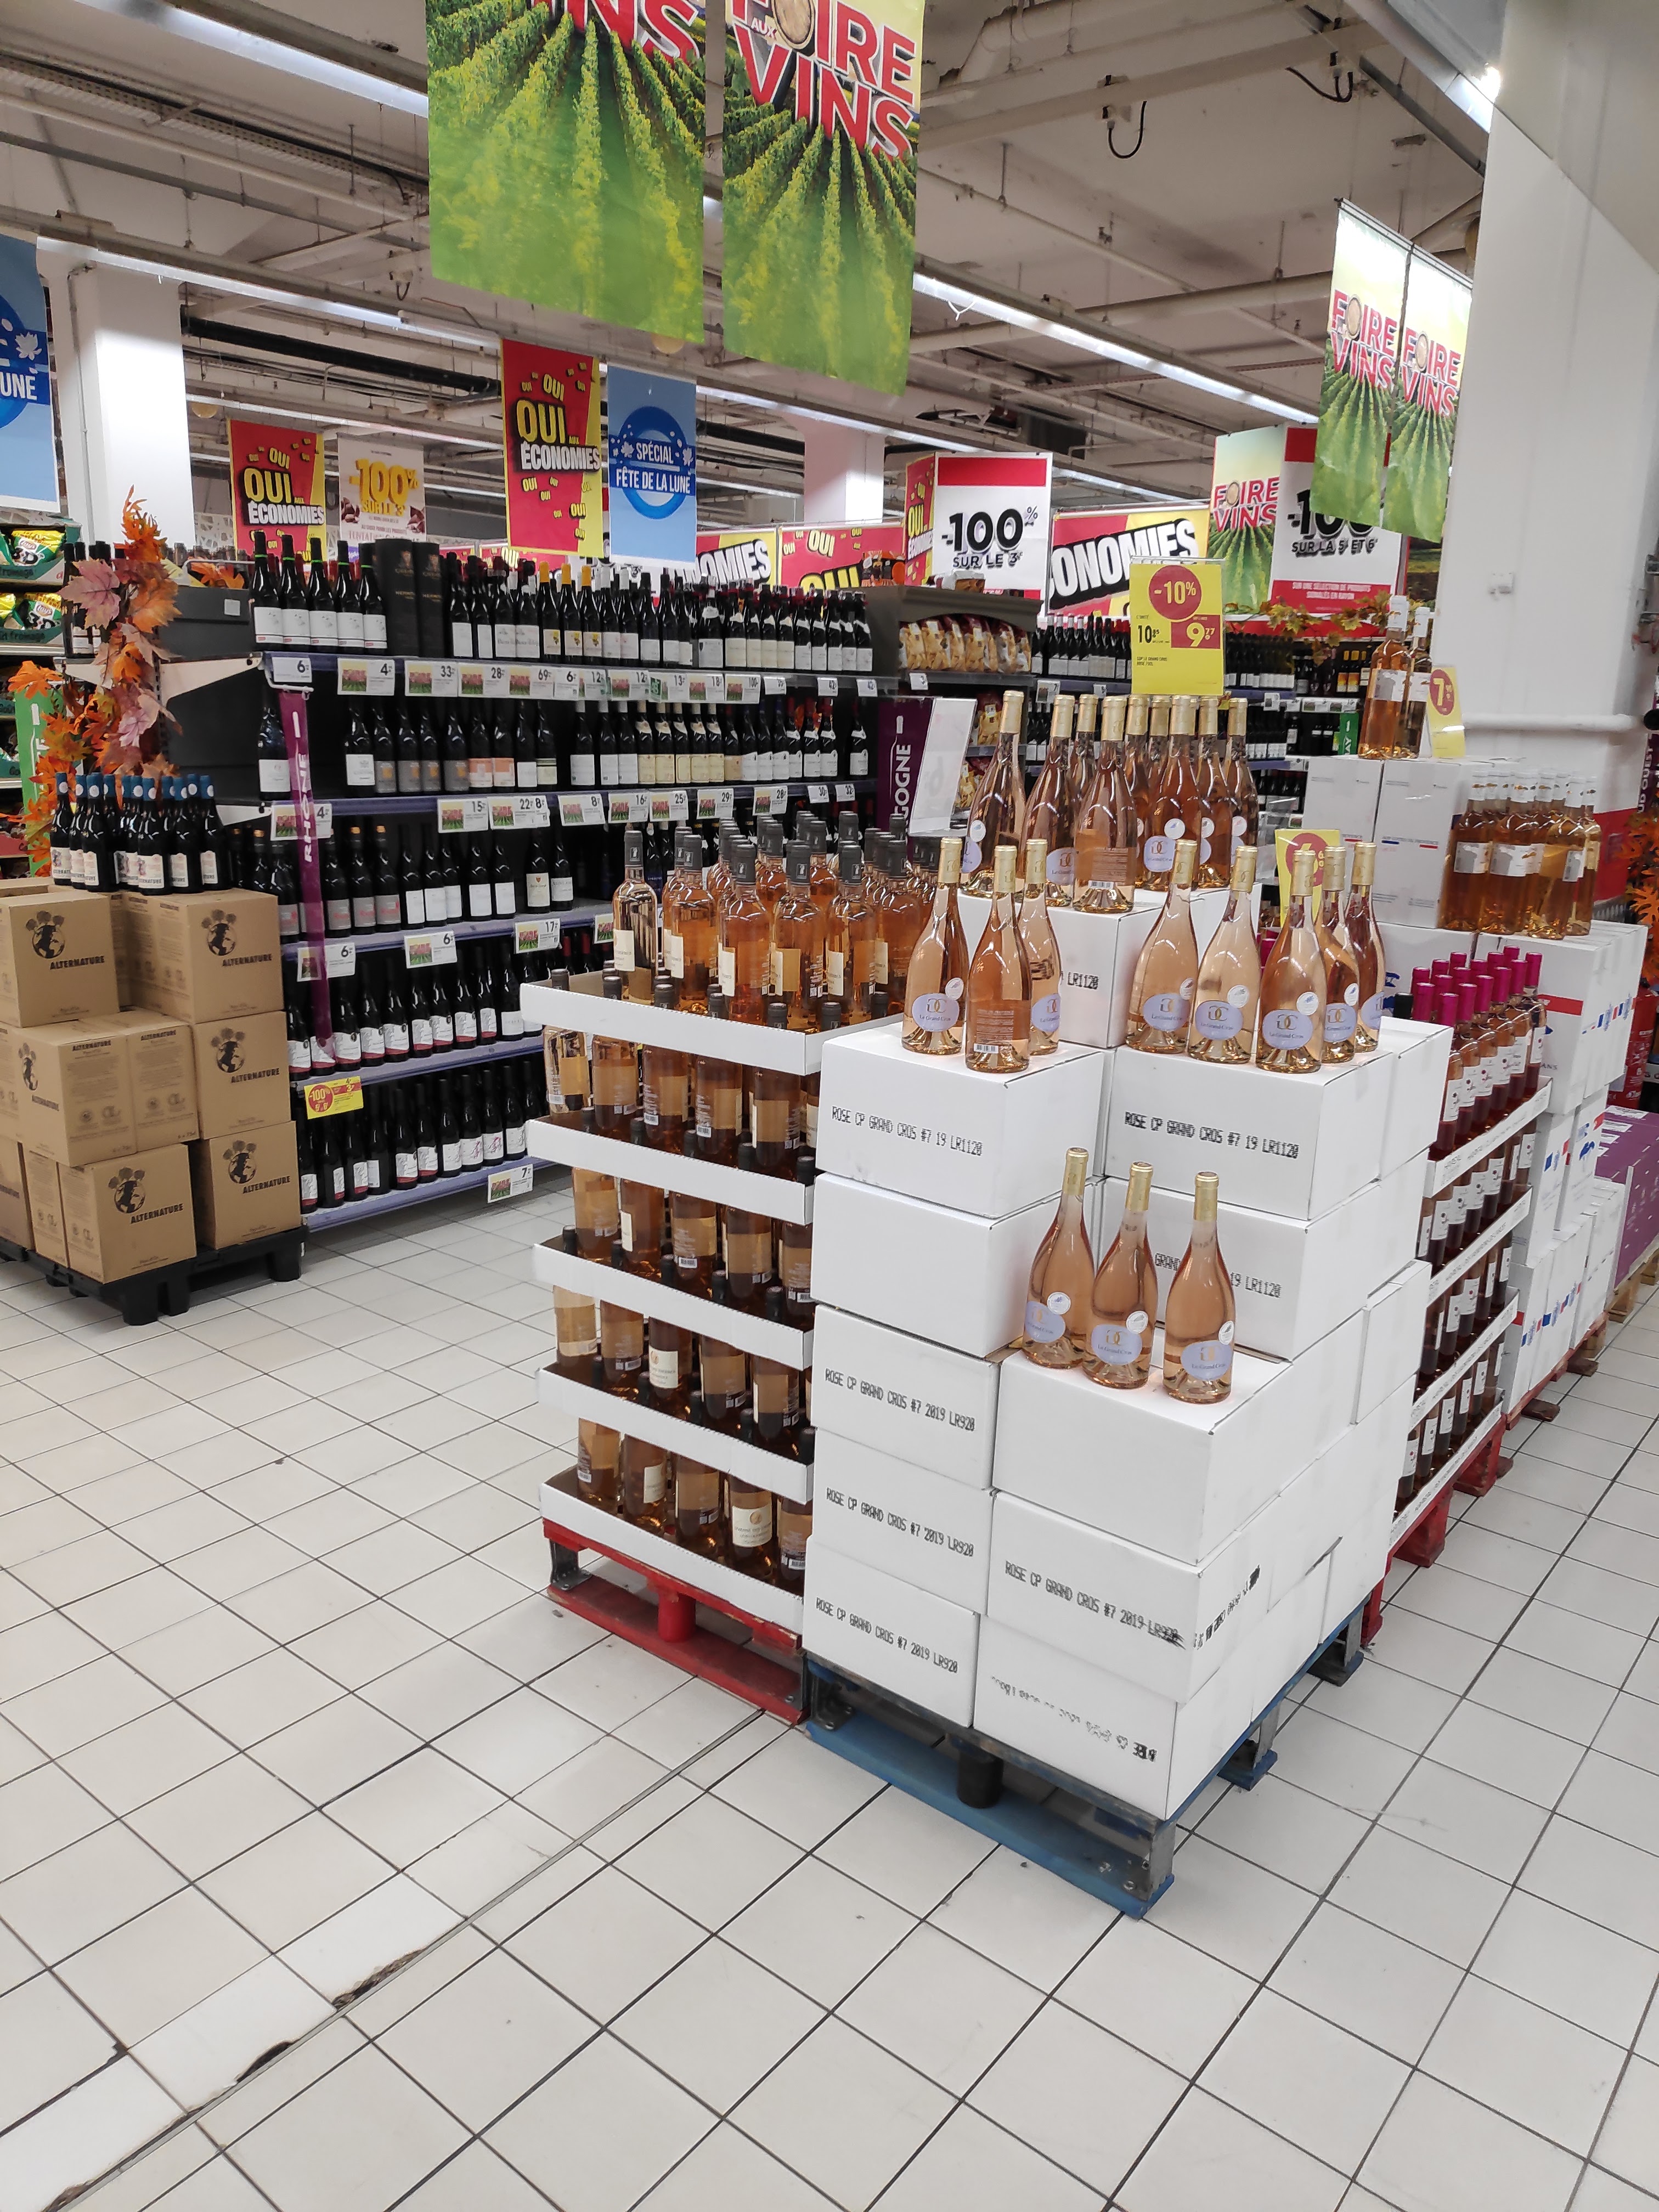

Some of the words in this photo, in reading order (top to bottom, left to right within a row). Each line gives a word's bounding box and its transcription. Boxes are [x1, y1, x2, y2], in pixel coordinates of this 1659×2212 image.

[751, 16, 777, 40] AUX
[733, 23, 915, 163] VINS
[1331, 290, 1397, 357] FOIRE
[1330, 331, 1393, 389] VINS
[1402, 327, 1462, 387] FOIRE
[0, 372, 37, 400] UNE
[543, 374, 565, 402] OUI
[1402, 364, 1457, 416] VINS
[517, 399, 566, 444] OUI
[269, 448, 290, 469] OUI
[521, 441, 601, 470] ÉCONOMIES
[636, 440, 674, 465] SPÉCIAL
[244, 468, 292, 504] OUI
[522, 477, 538, 492] OUI
[616, 466, 640, 489] FÊTE
[642, 471, 654, 490] DE
[656, 472, 668, 492] LA
[669, 473, 691, 494] LUNE
[1214, 476, 1280, 509] FOIRE
[540, 490, 550, 501] OUI
[248, 501, 325, 524] ÉCONOMIES
[571, 503, 585, 517] OUI
[909, 504, 924, 538] OUI
[1214, 504, 1278, 532] VINS
[941, 505, 1038, 552] -100%
[783, 543, 795, 555] OUI
[808, 529, 835, 557] OUI
[1291, 541, 1314, 553] SUR
[1319, 540, 1334, 551] LA
[1352, 539, 1364, 549] ET
[953, 556, 979, 567] SUR
[986, 554, 1003, 565] LE
[1049, 520, 1198, 601] ONOMIES
[1154, 581, 1197, 604] -10%
[1137, 625, 1152, 644] 10
[1433, 678, 1445, 706] 7
[443, 933, 450, 945] 6
[545, 921, 554, 932] 17
[50, 956, 105, 970] ALTERNATURE
[222, 953, 273, 967] ALTERNATURE
[341, 945, 348, 957] 6
[231, 1068, 280, 1084] ALTERNATURE
[936, 1131, 947, 1147] 19
[242, 1176, 291, 1194] ALTERNATURE
[522, 1167, 528, 1178] 7
[130, 1203, 184, 1224] ALTERNATURE
[825, 1368, 844, 1386] ROSE
[847, 1375, 856, 1390] CP
[860, 1381, 884, 1400] GRAND
[887, 1390, 907, 1409] CROS
[911, 1398, 921, 1413] #7
[925, 1403, 946, 1421] 2019
[826, 1487, 844, 1506] ROSE
[848, 1497, 857, 1510] CP
[861, 1502, 884, 1522] GRAND
[888, 1512, 907, 1531] CROS
[924, 1527, 944, 1545] 2019
[1005, 1560, 1026, 1583] ROSE
[1030, 1572, 1042, 1587] CP
[1077, 1592, 1099, 1613] CROS
[1120, 1609, 1146, 1629] 2019
[816, 1596, 834, 1617] ROSE
[837, 1607, 846, 1622] CP
[849, 1613, 872, 1634] GRAND
[875, 1626, 894, 1645] CROS
[911, 1642, 930, 1661] 2019
